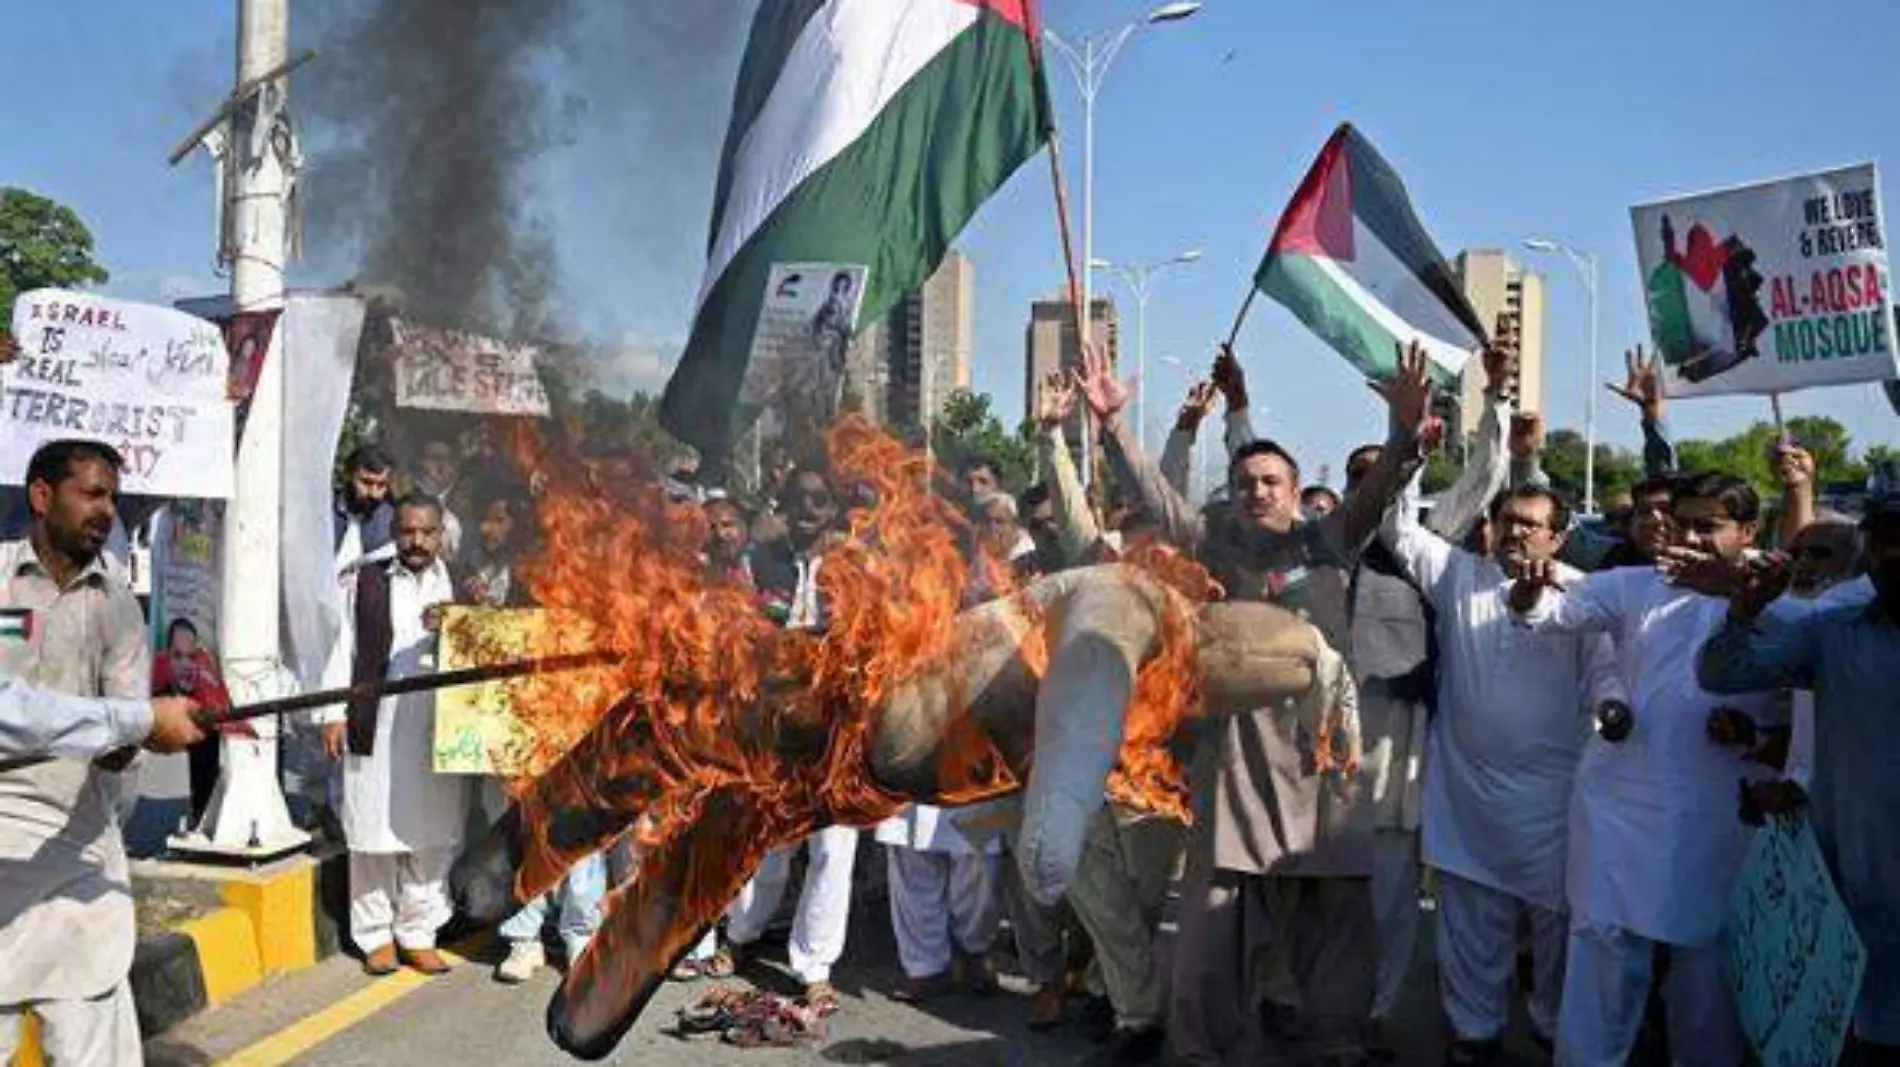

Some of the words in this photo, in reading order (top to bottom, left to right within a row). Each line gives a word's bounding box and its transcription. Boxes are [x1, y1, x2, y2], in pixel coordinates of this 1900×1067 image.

[1804, 196, 1830, 225] WE
[1833, 189, 1875, 219] LOVE
[1799, 231, 1812, 258] &
[1770, 262, 1884, 318] AL-AQSA
[31, 301, 126, 331] ISRAEL
[41, 326, 66, 354] IS
[1774, 311, 1887, 363] MOSQUE
[16, 354, 82, 387] REAL
[6, 386, 197, 442] TERRORIST
